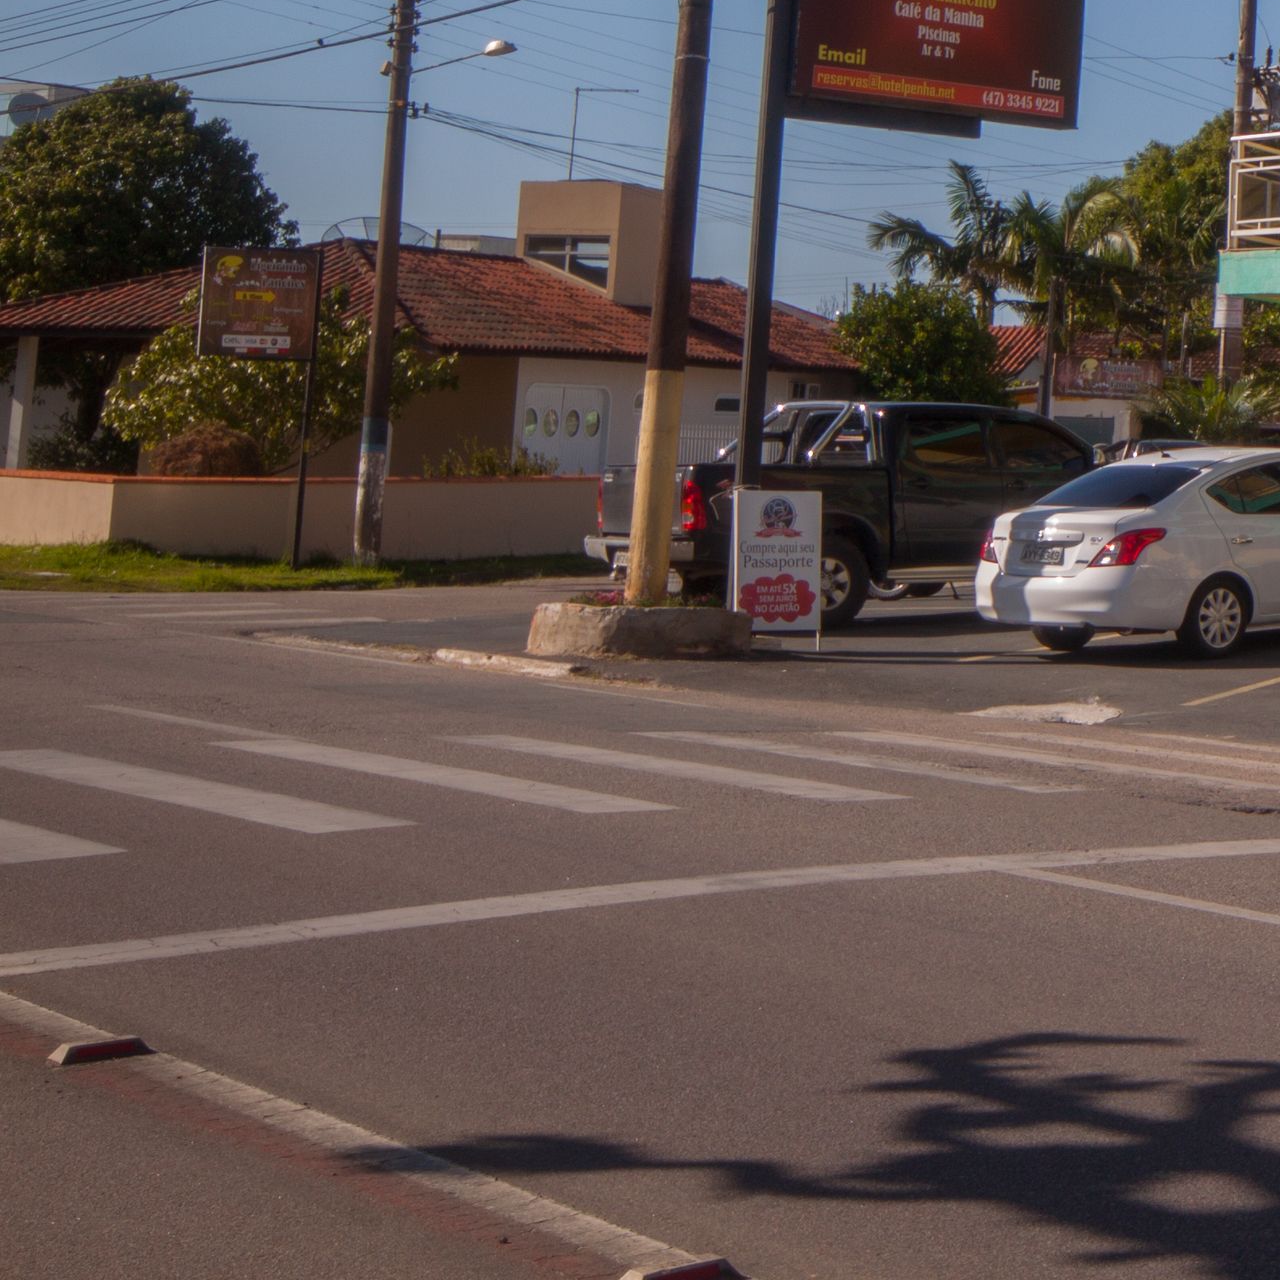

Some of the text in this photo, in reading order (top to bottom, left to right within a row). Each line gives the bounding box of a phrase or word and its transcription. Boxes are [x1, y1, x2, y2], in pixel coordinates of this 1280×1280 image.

[895, 0, 921, 19] Café
[925, 5, 940, 22] da
[917, 25, 960, 44] Piscinas
[818, 44, 866, 65] Email
[922, 44, 933, 56] Ar
[934, 46, 942, 57] &
[817, 71, 955, 100] reservas@hotelpenha.net
[1031, 70, 1061, 91] Fone
[982, 91, 1060, 113] (47) 3345 9221
[740, 541, 815, 557] Compre aqui seu
[744, 555, 813, 571] Passaporte
[756, 585, 768, 593] EM
[783, 583, 797, 594] 5X
[769, 603, 800, 613] CARTÃO
